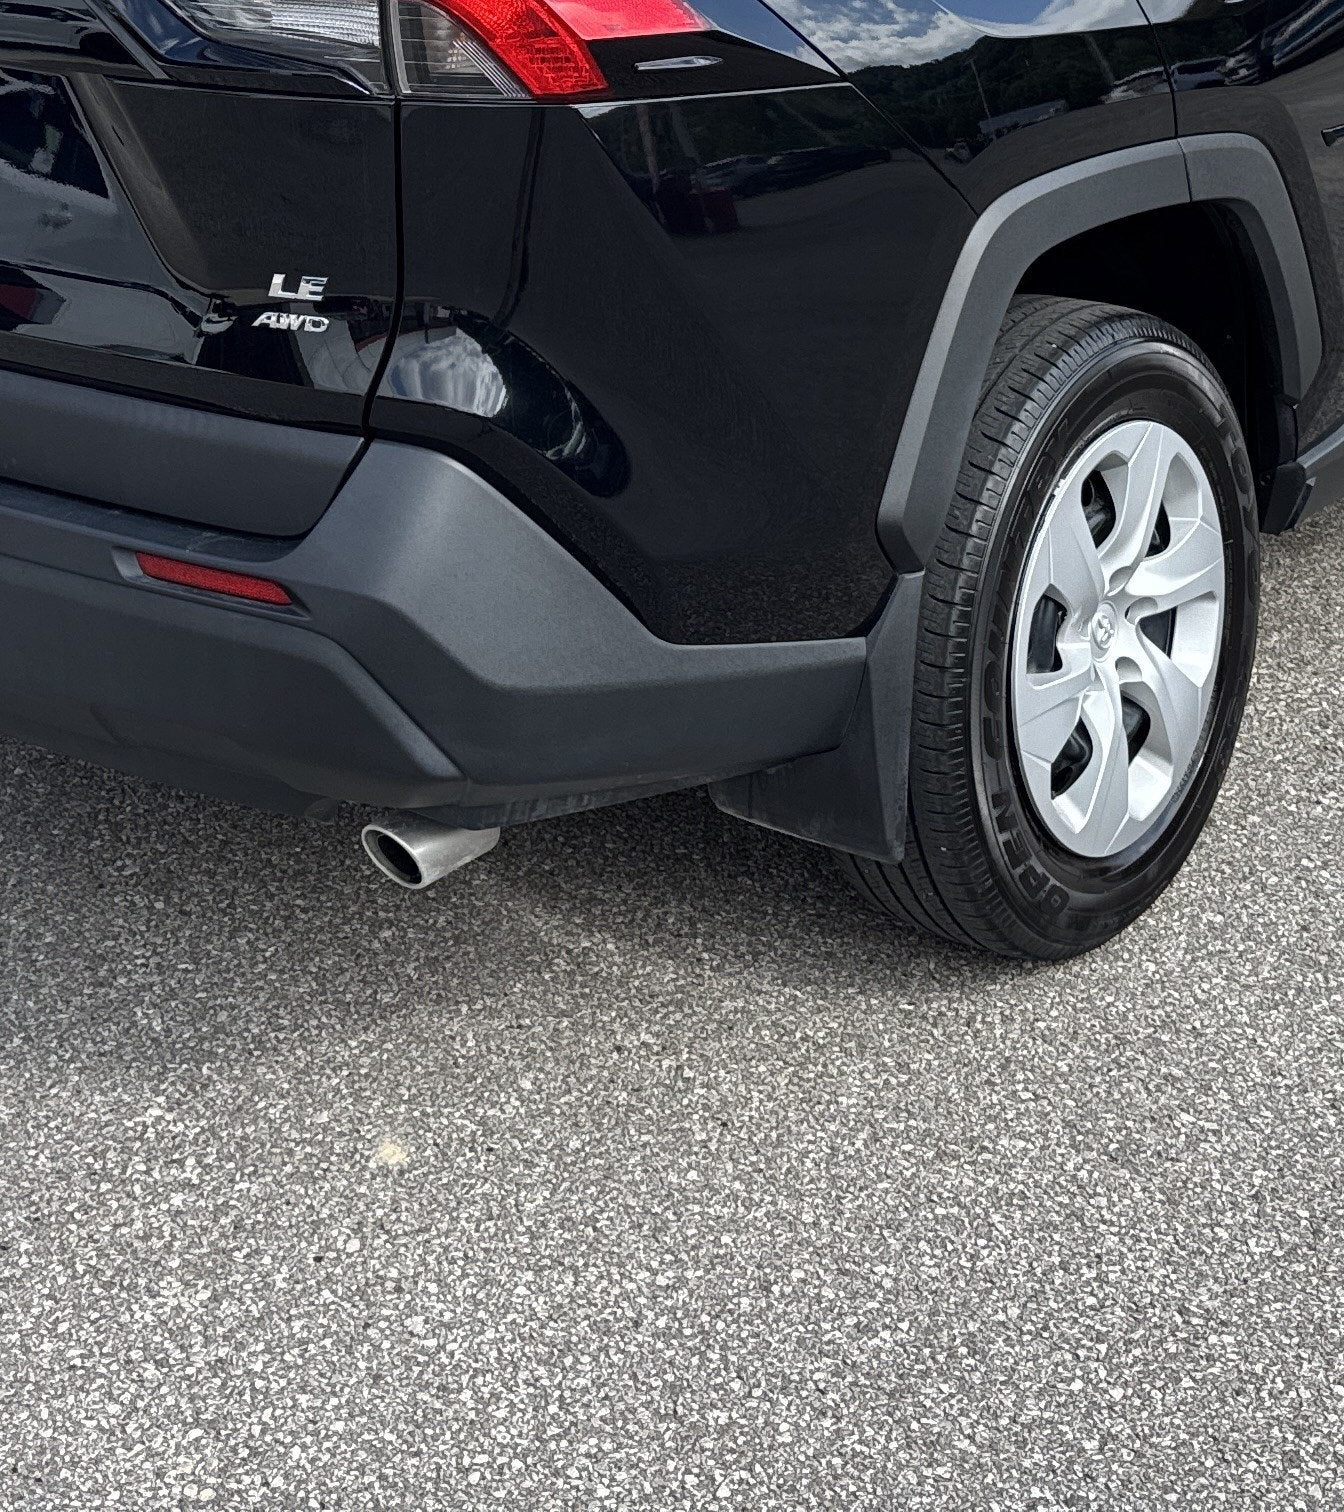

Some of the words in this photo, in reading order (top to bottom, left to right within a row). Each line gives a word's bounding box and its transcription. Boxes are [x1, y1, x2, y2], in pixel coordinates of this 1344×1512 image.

[268, 273, 328, 301] LE
[251, 312, 329, 333] AWD
[991, 791, 1070, 916] OPEN
